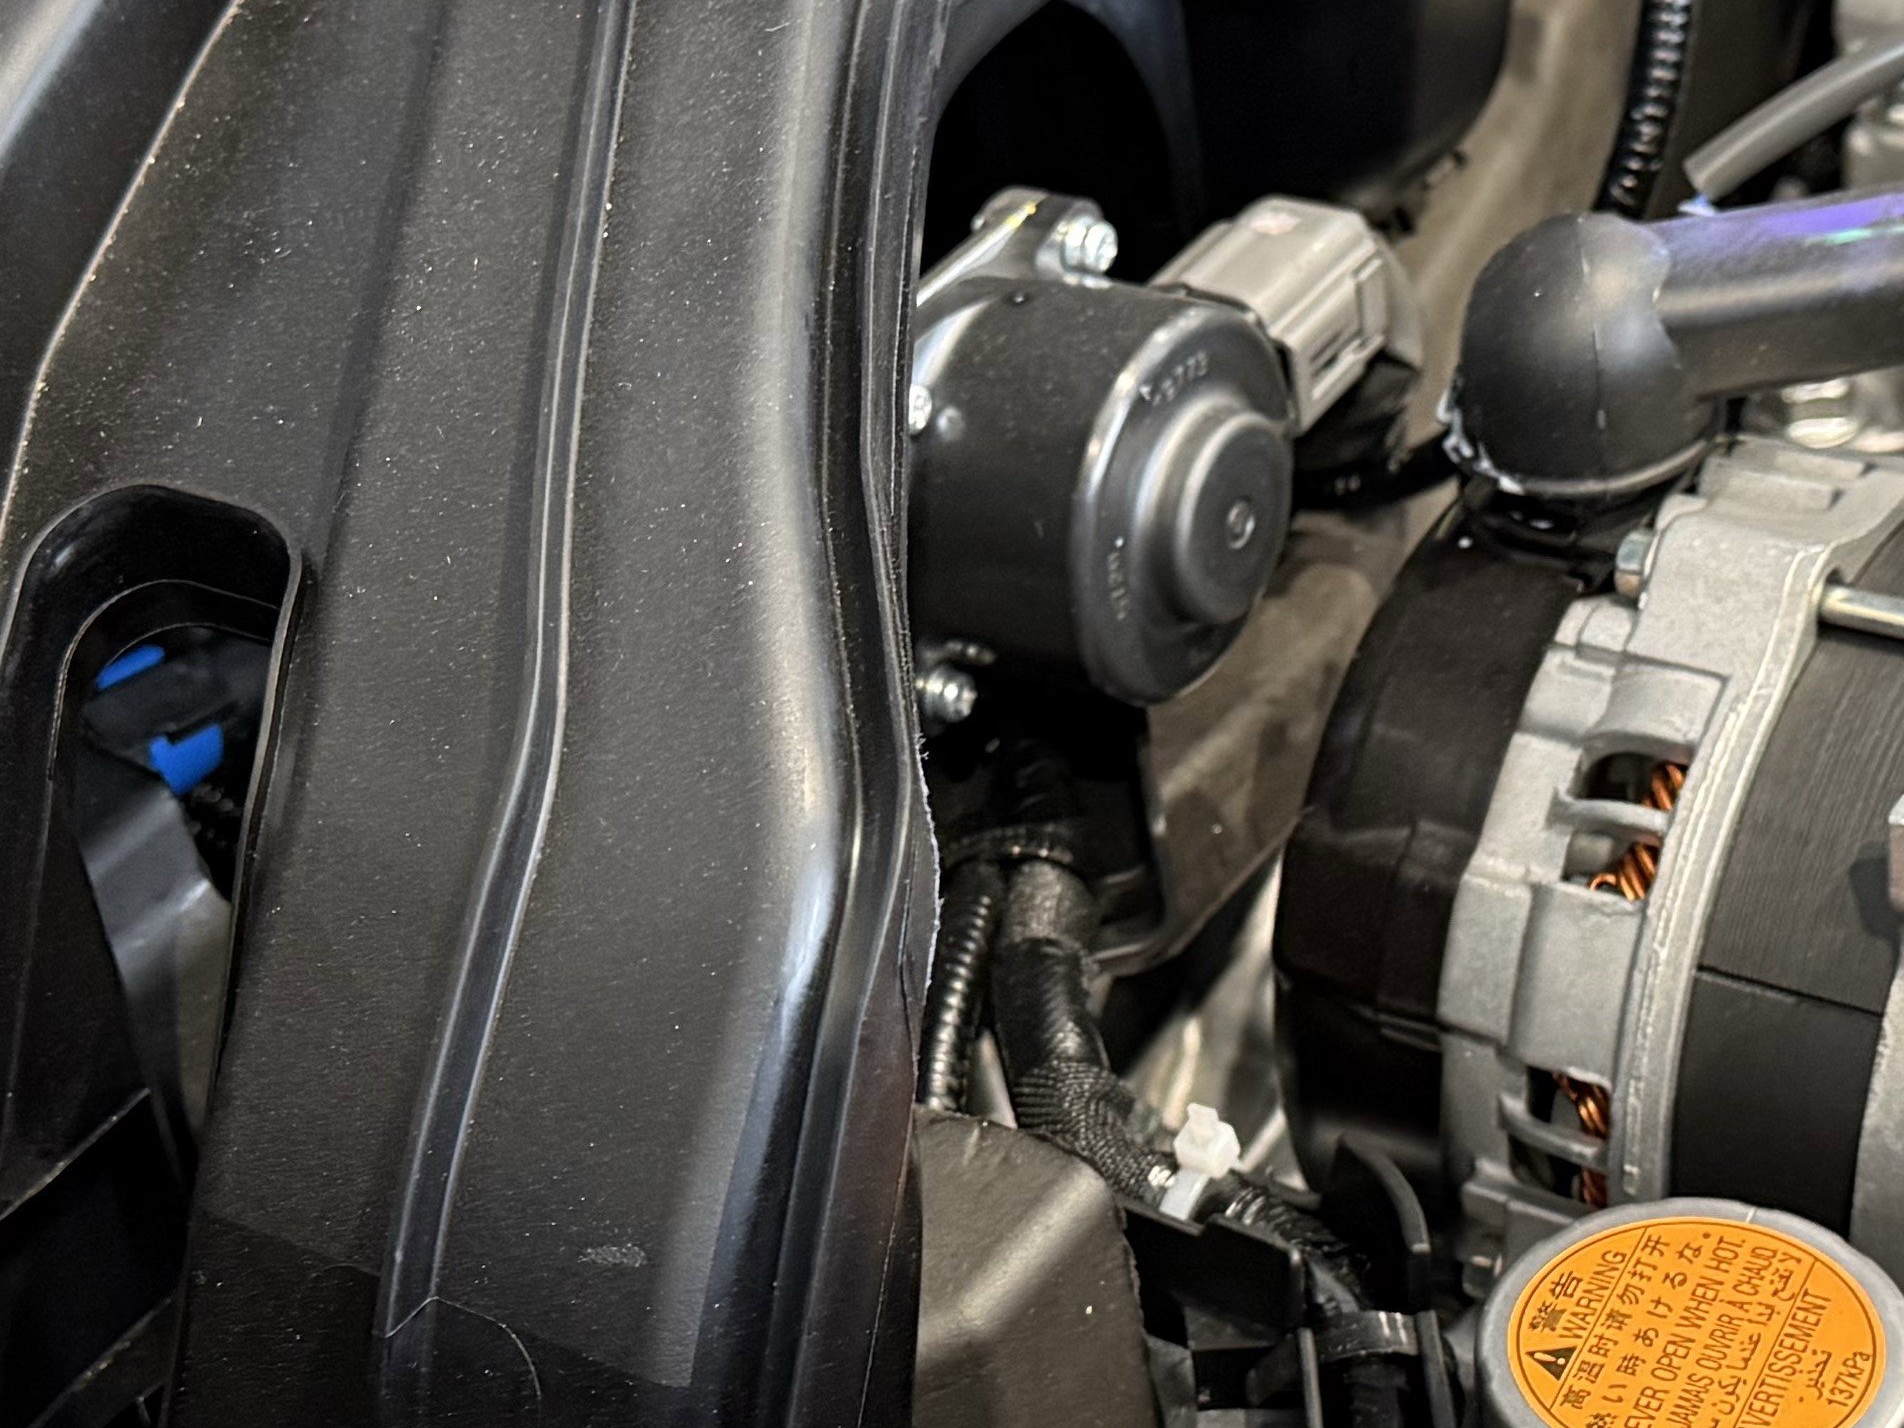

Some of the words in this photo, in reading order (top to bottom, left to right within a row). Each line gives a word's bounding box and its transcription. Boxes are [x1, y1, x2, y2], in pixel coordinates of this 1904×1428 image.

[1528, 1270, 1583, 1332] 警告
[1558, 1250, 1627, 1339] WARNING
[1559, 1234, 1670, 1410] 高温时请勿打开
[1650, 1333, 1696, 1381] OPEN
[1676, 1276, 1725, 1329] WHEN
[1695, 1313, 1745, 1371] OUVRIR
[1826, 1351, 1871, 1407] 137kPa
